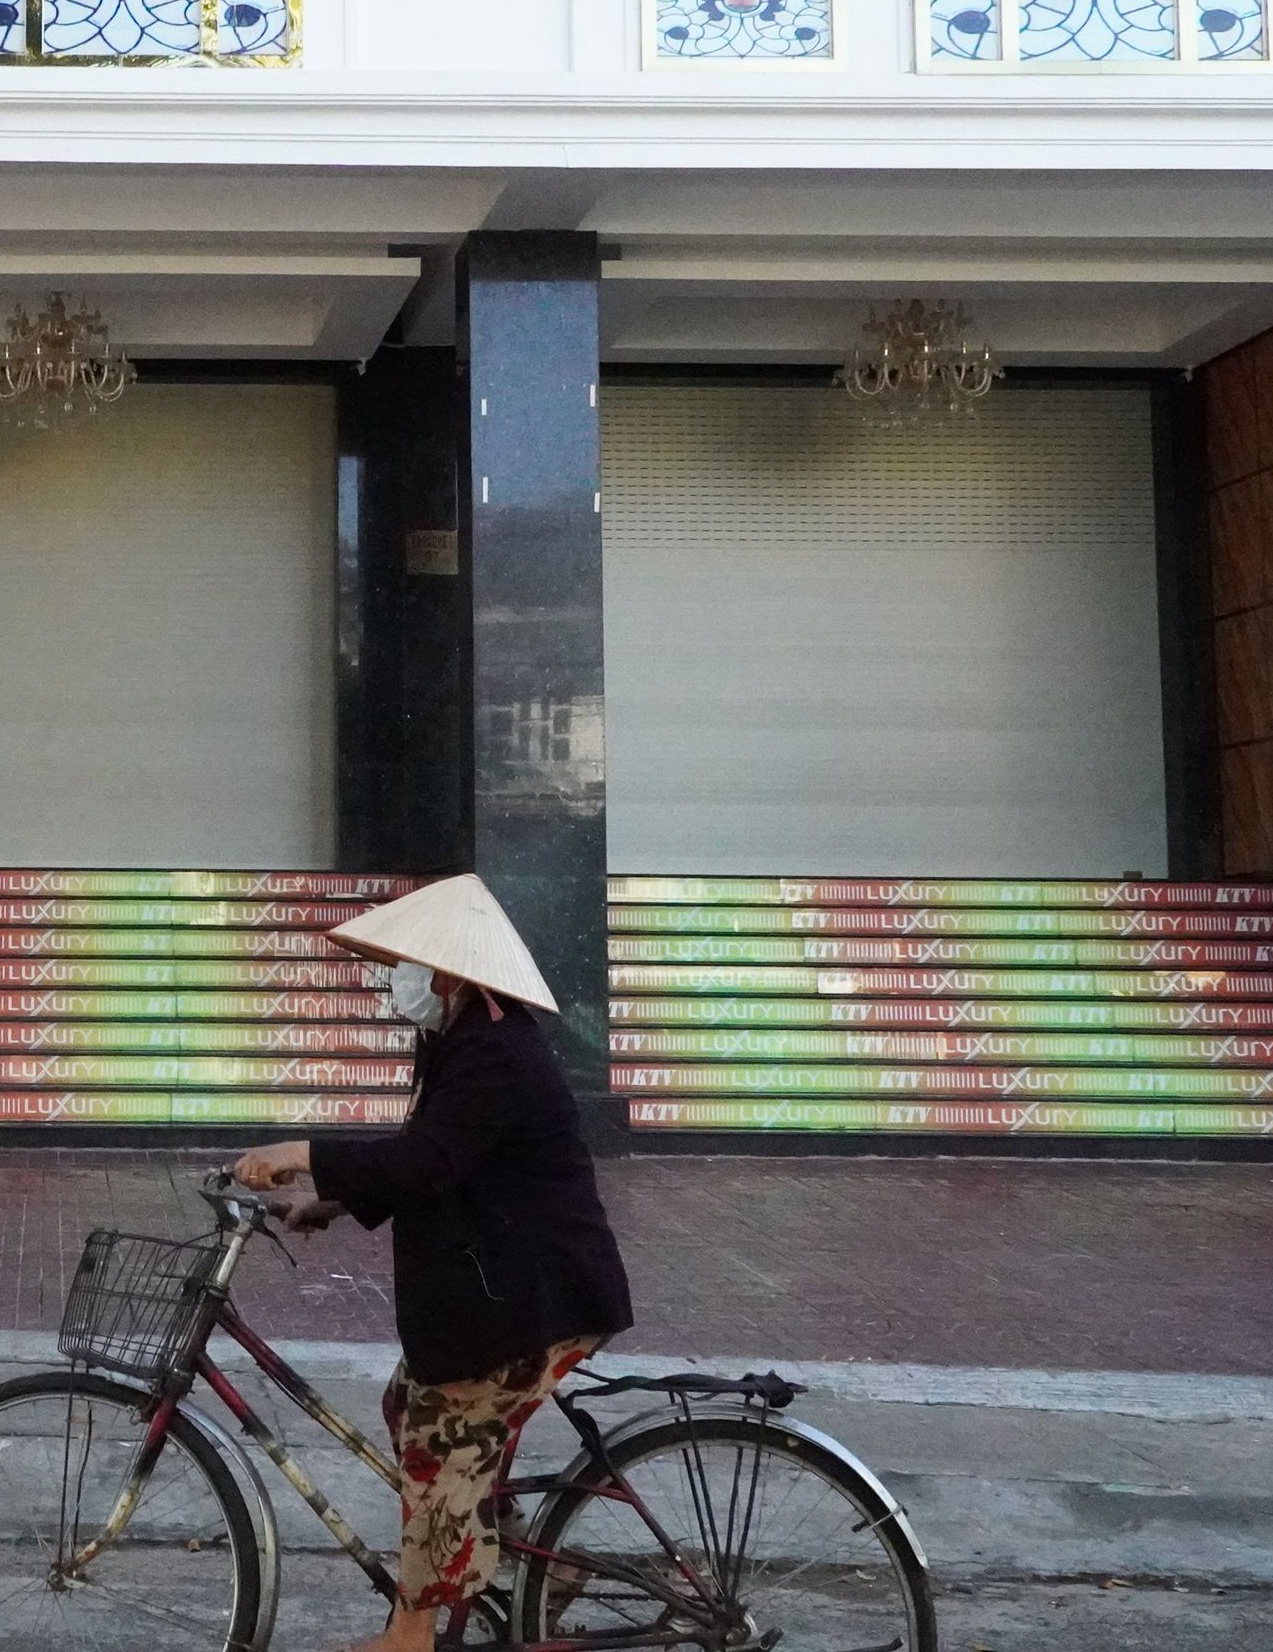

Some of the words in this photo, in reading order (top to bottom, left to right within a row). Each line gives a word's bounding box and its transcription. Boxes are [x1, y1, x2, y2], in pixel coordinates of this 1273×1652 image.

[356, 879, 395, 893] KTV
[1215, 888, 1255, 903] KTV
[792, 912, 830, 928] KTV
[1235, 916, 1273, 932] KTV
[804, 942, 843, 958] KTV
[609, 1001, 635, 1017] TV
[831, 1004, 872, 1020] KTV
[385, 1031, 416, 1047] KT
[846, 1036, 888, 1053] KTV
[633, 1069, 677, 1086] KTV
[880, 1071, 924, 1088] KTV
[1228, 1071, 1273, 1097] LUX
[640, 1104, 684, 1120] KTV
[887, 1107, 931, 1123] KTV
